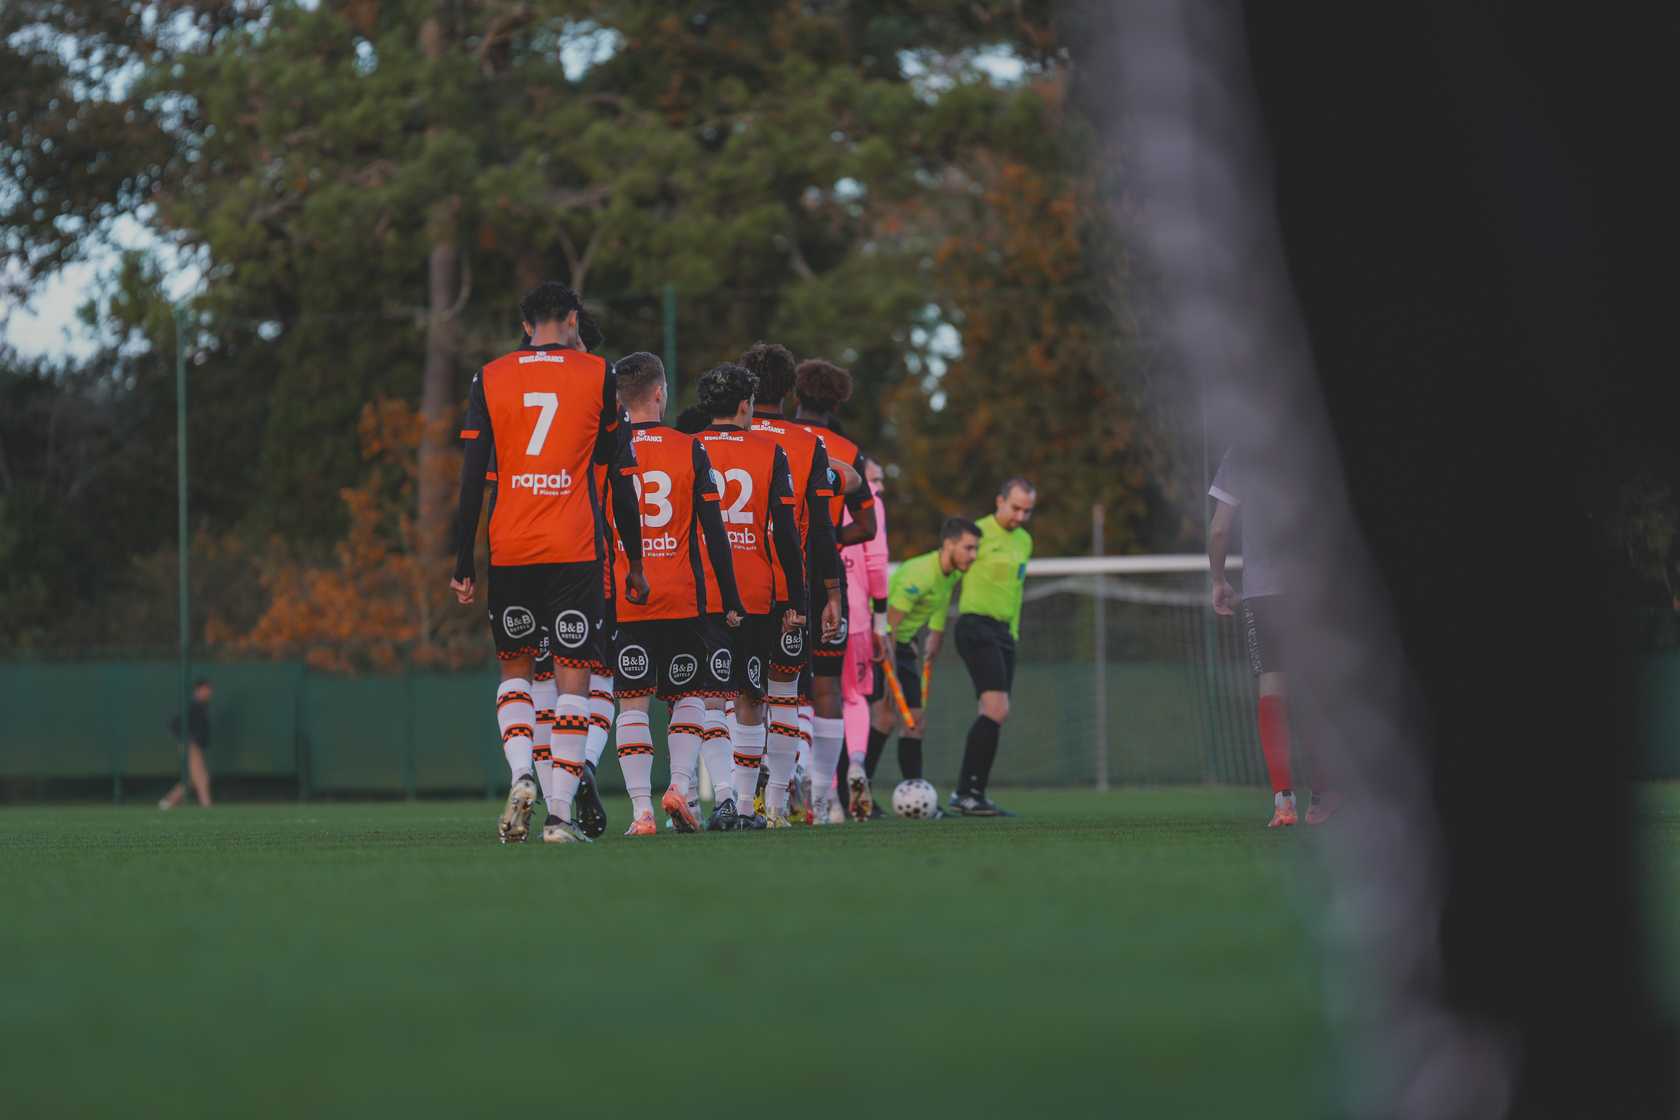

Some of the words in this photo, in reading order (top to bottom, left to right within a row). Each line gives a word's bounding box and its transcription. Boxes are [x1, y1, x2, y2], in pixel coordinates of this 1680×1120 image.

[523, 392, 559, 456] 7
[511, 469, 572, 496] napab
[632, 470, 673, 528] 3
[506, 615, 532, 628] B&B
[559, 621, 585, 634] B&B
[785, 635, 800, 644] B&
[622, 655, 646, 667] B&B
[672, 663, 694, 674] B&B
